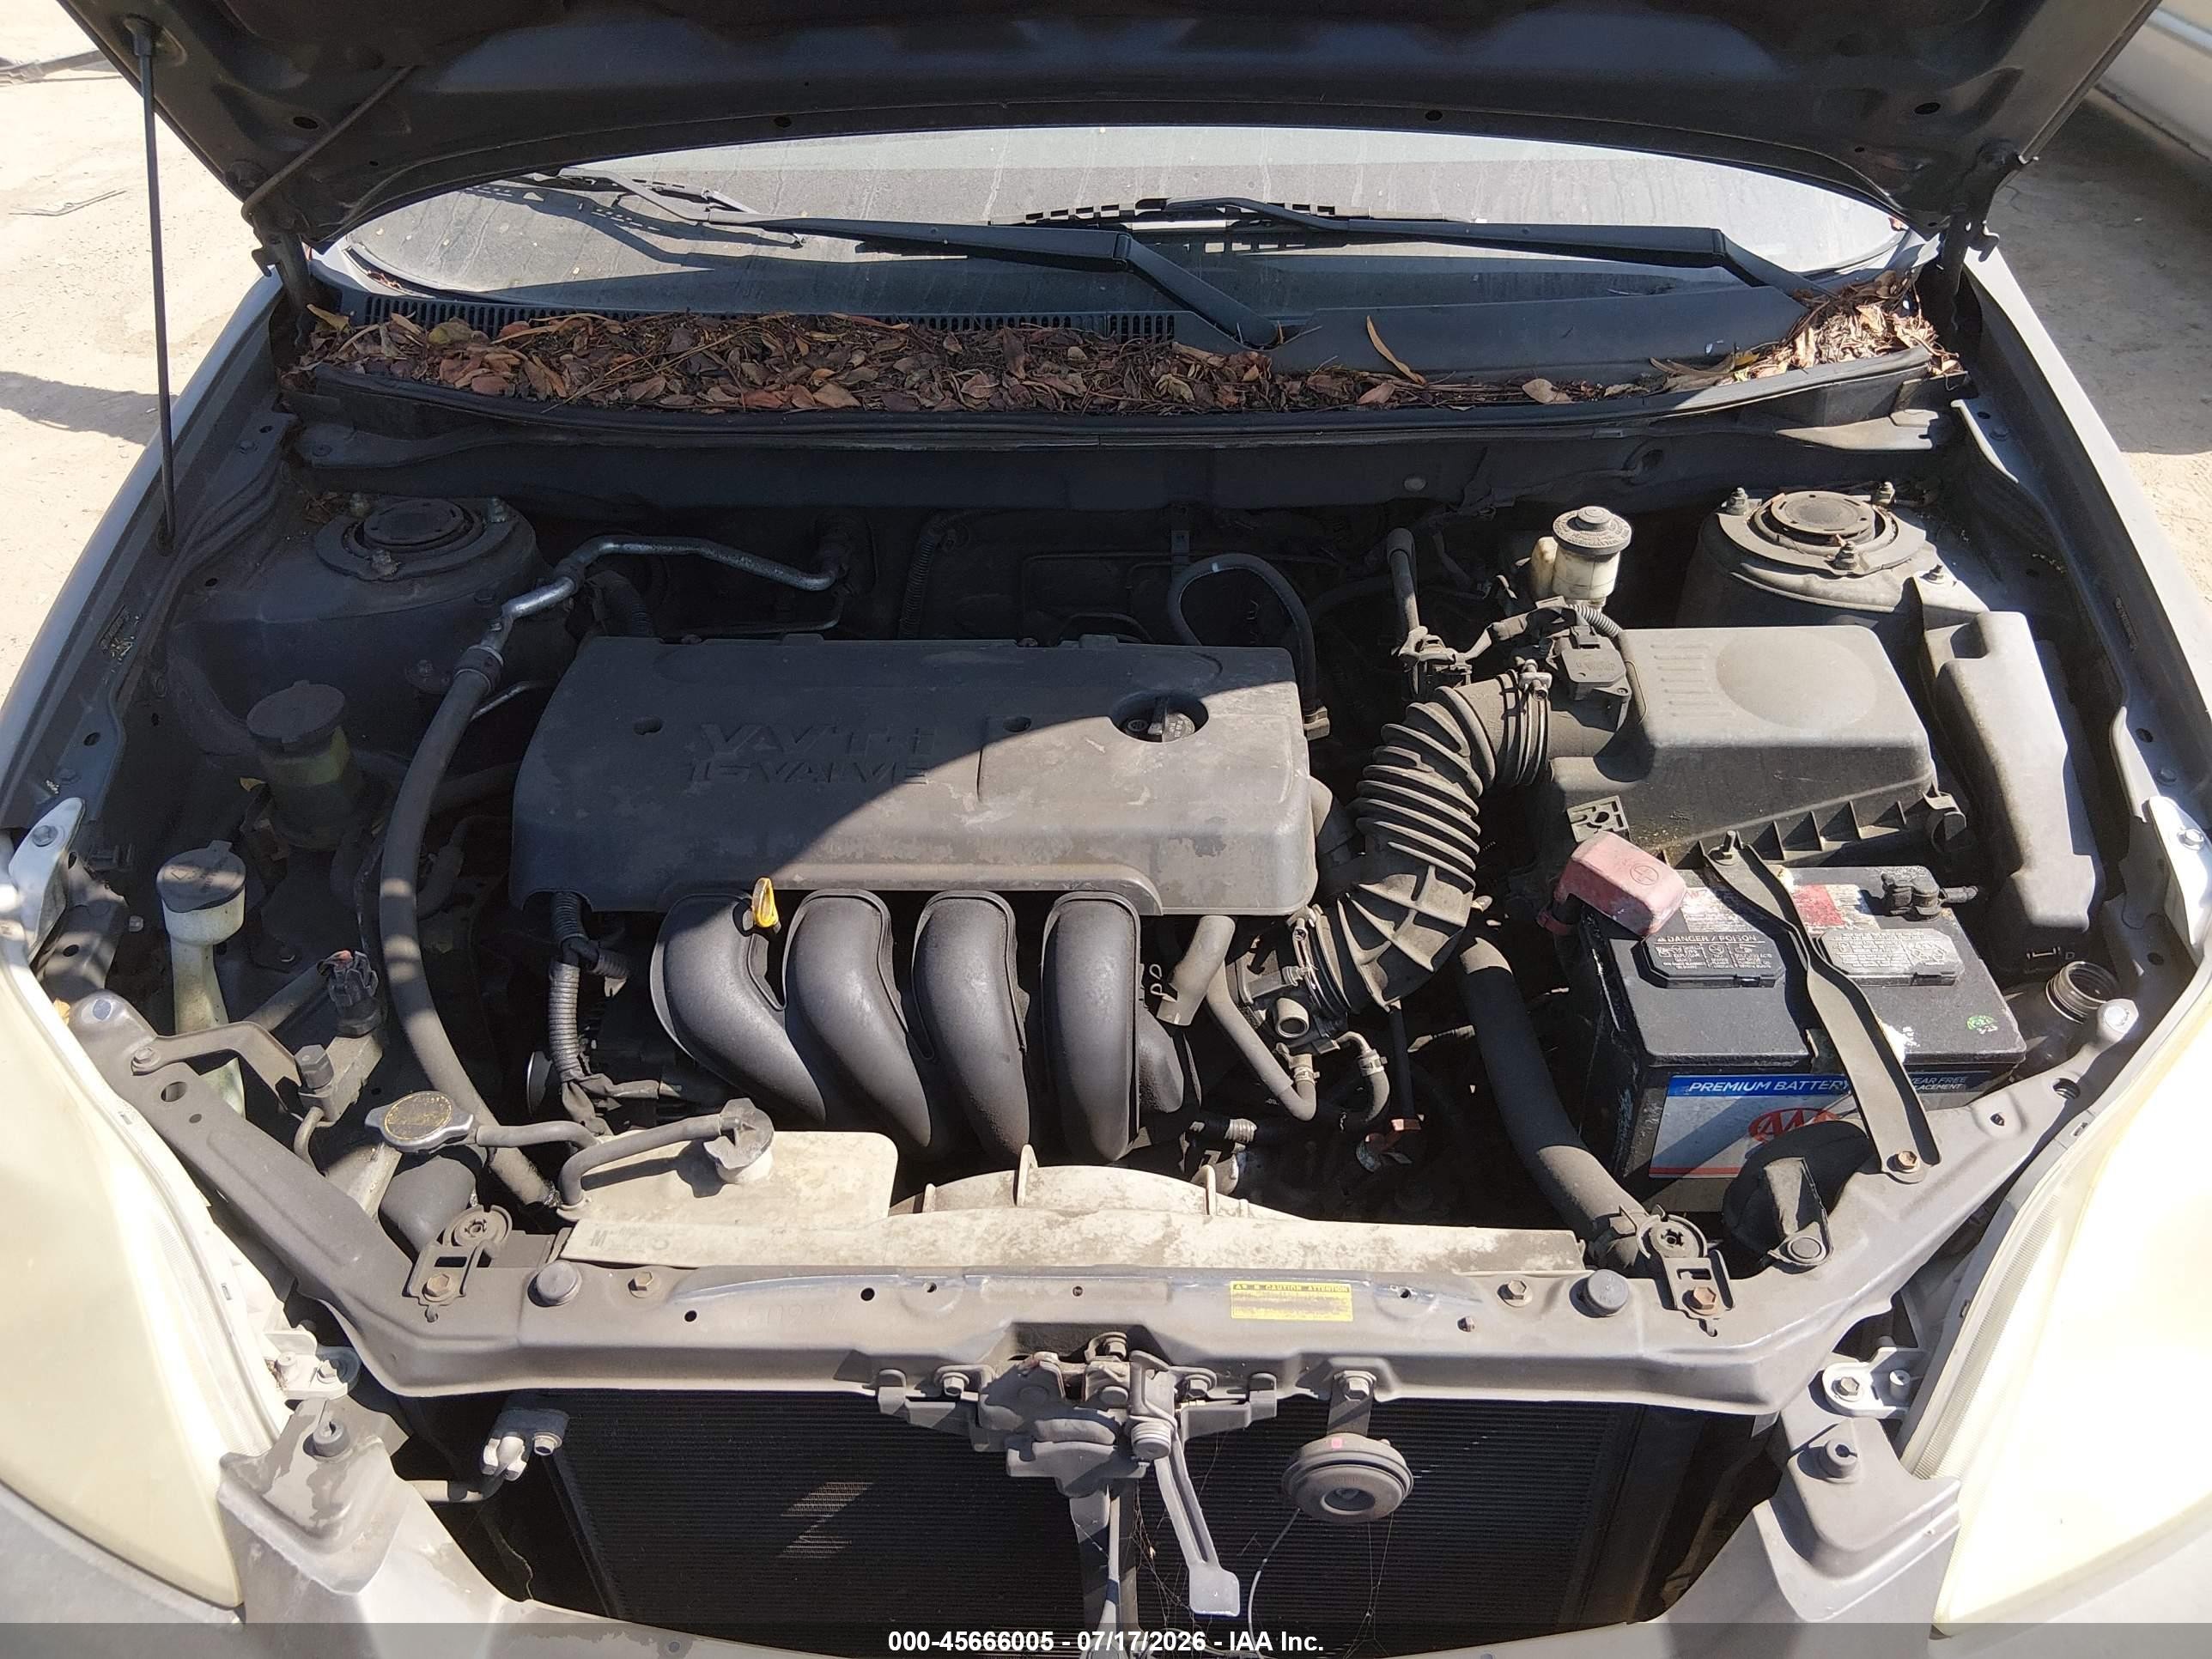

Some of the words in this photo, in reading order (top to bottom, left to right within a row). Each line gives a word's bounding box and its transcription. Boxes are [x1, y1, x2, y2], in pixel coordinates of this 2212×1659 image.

[1688, 1080, 1773, 1092] PREMIUM
[1774, 1079, 1850, 1091] BATTERY
[1937, 1076, 1967, 1085] FREE
